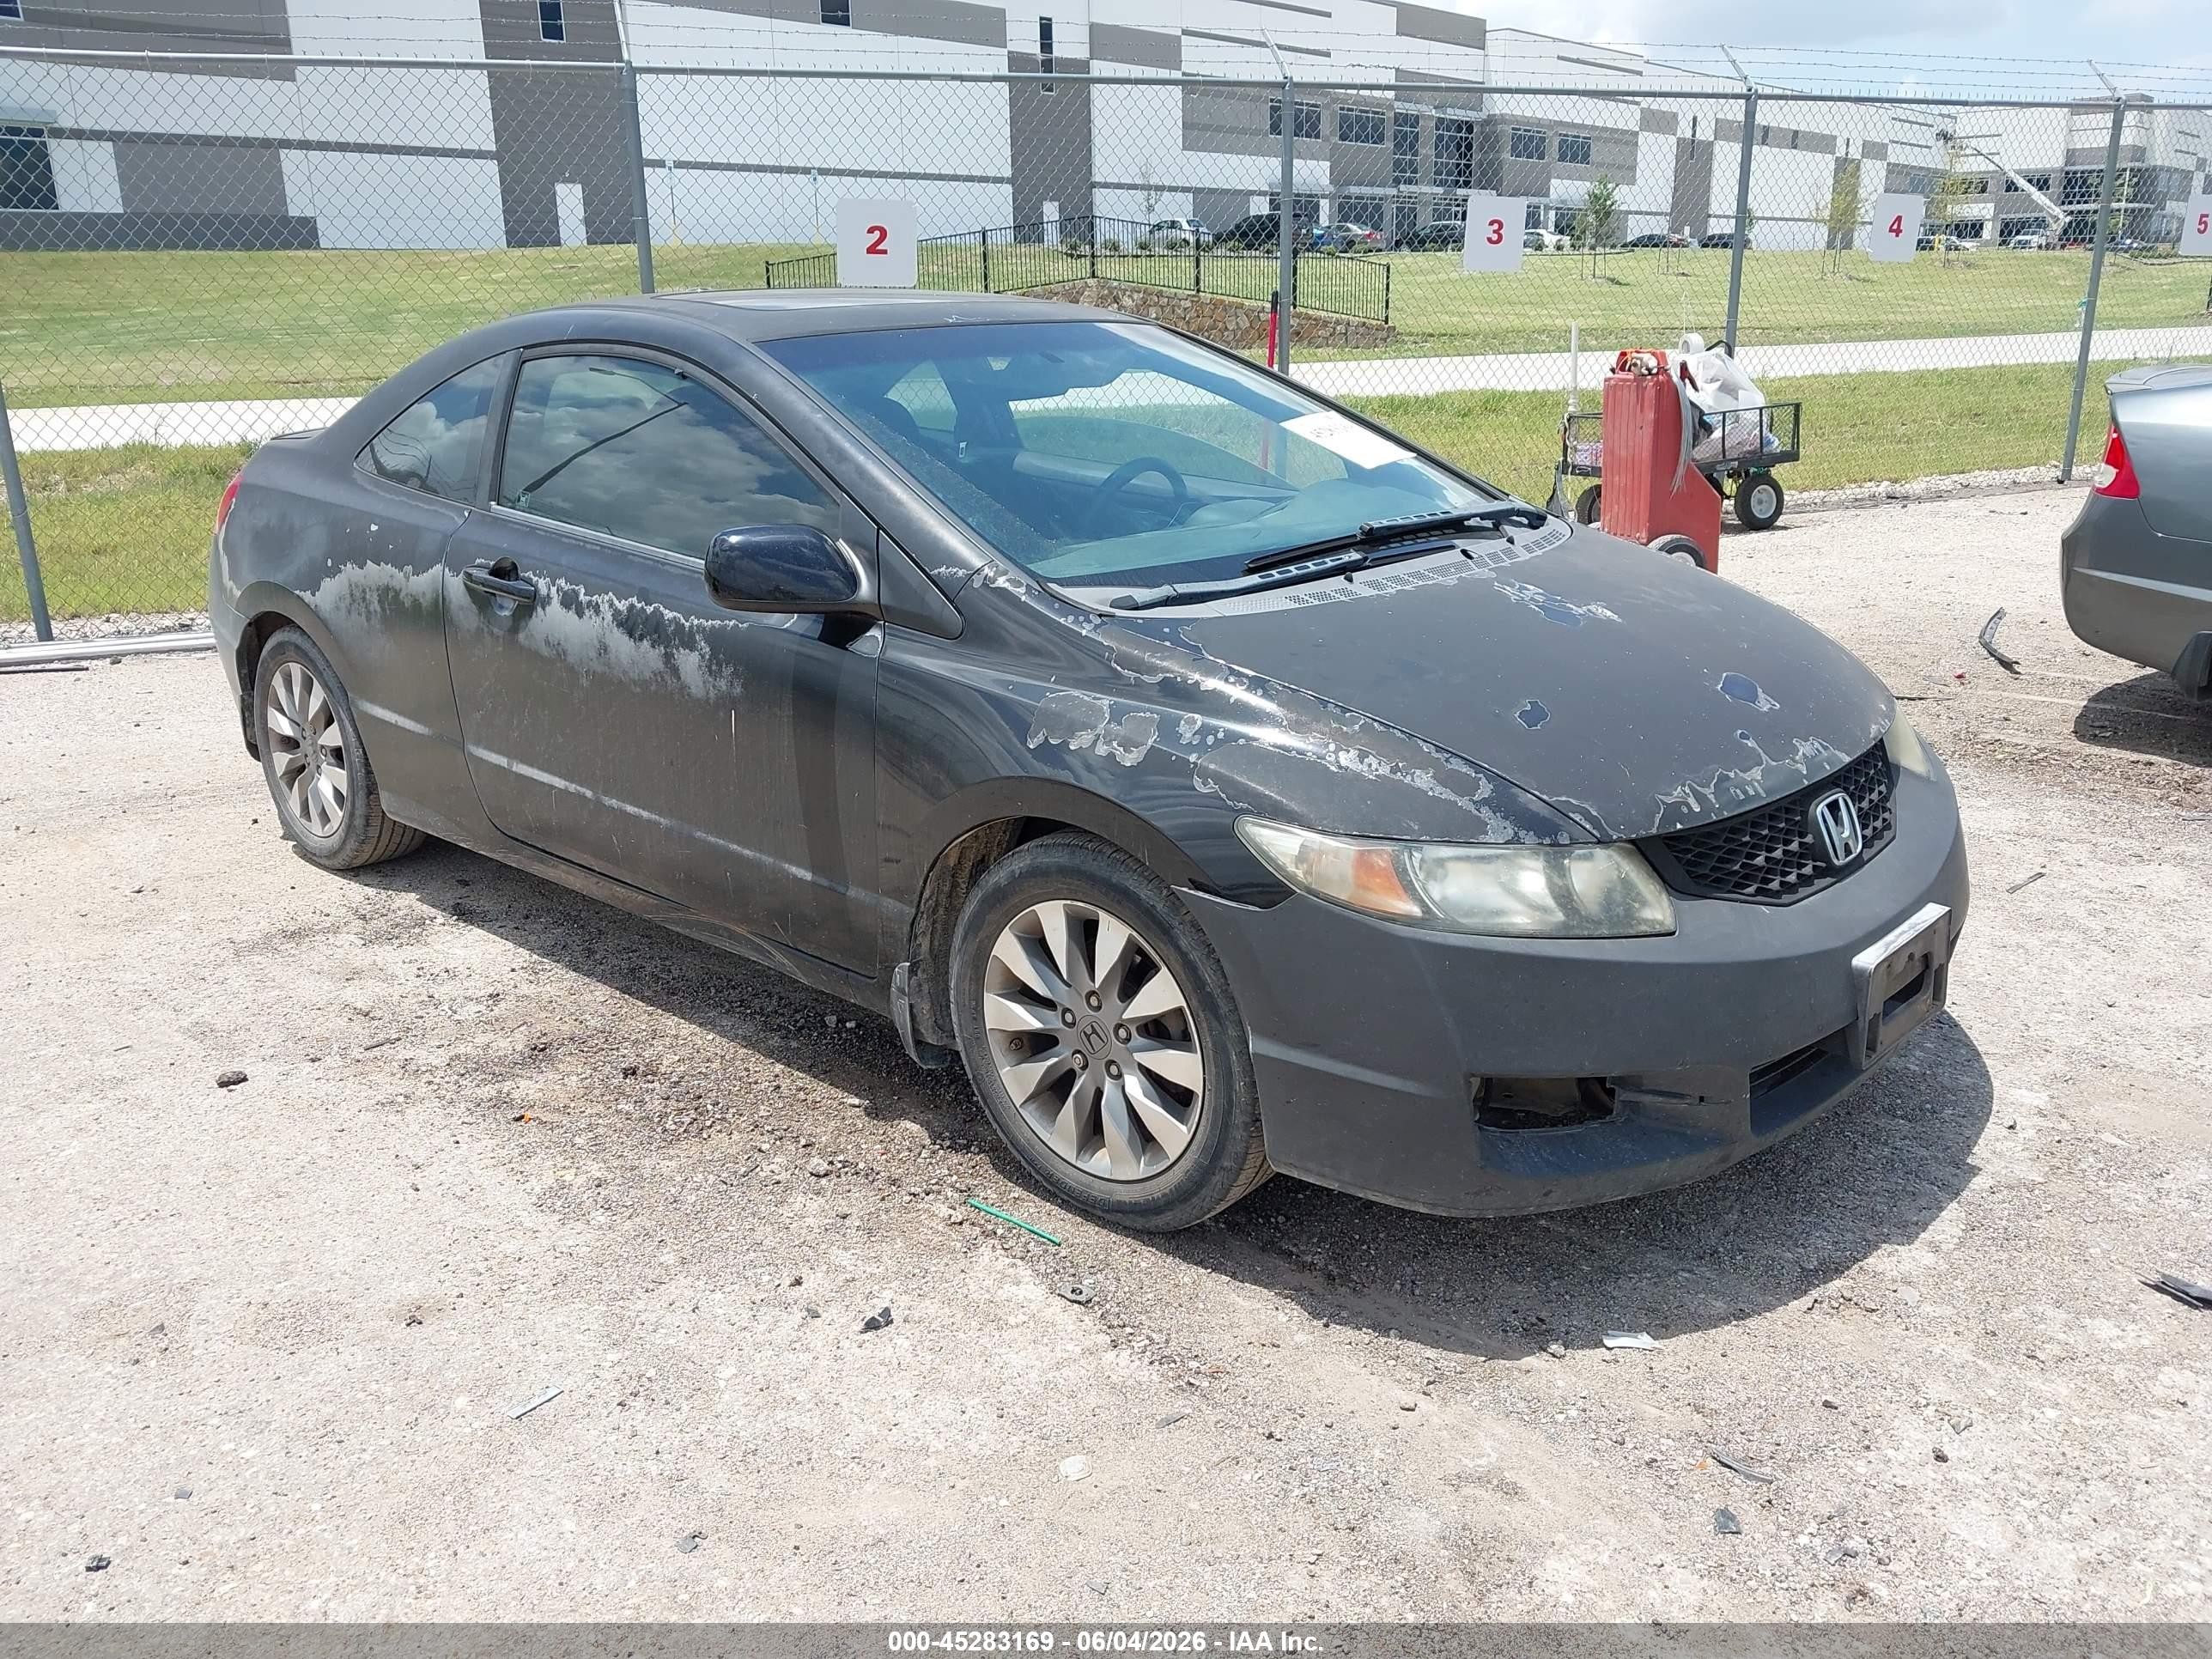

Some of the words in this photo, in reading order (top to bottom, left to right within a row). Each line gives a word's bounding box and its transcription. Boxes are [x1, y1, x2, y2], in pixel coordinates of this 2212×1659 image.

[1486, 218, 1504, 245] 3
[1888, 215, 1903, 238] 4
[2197, 213, 2209, 234] 5
[866, 225, 888, 255] 2
